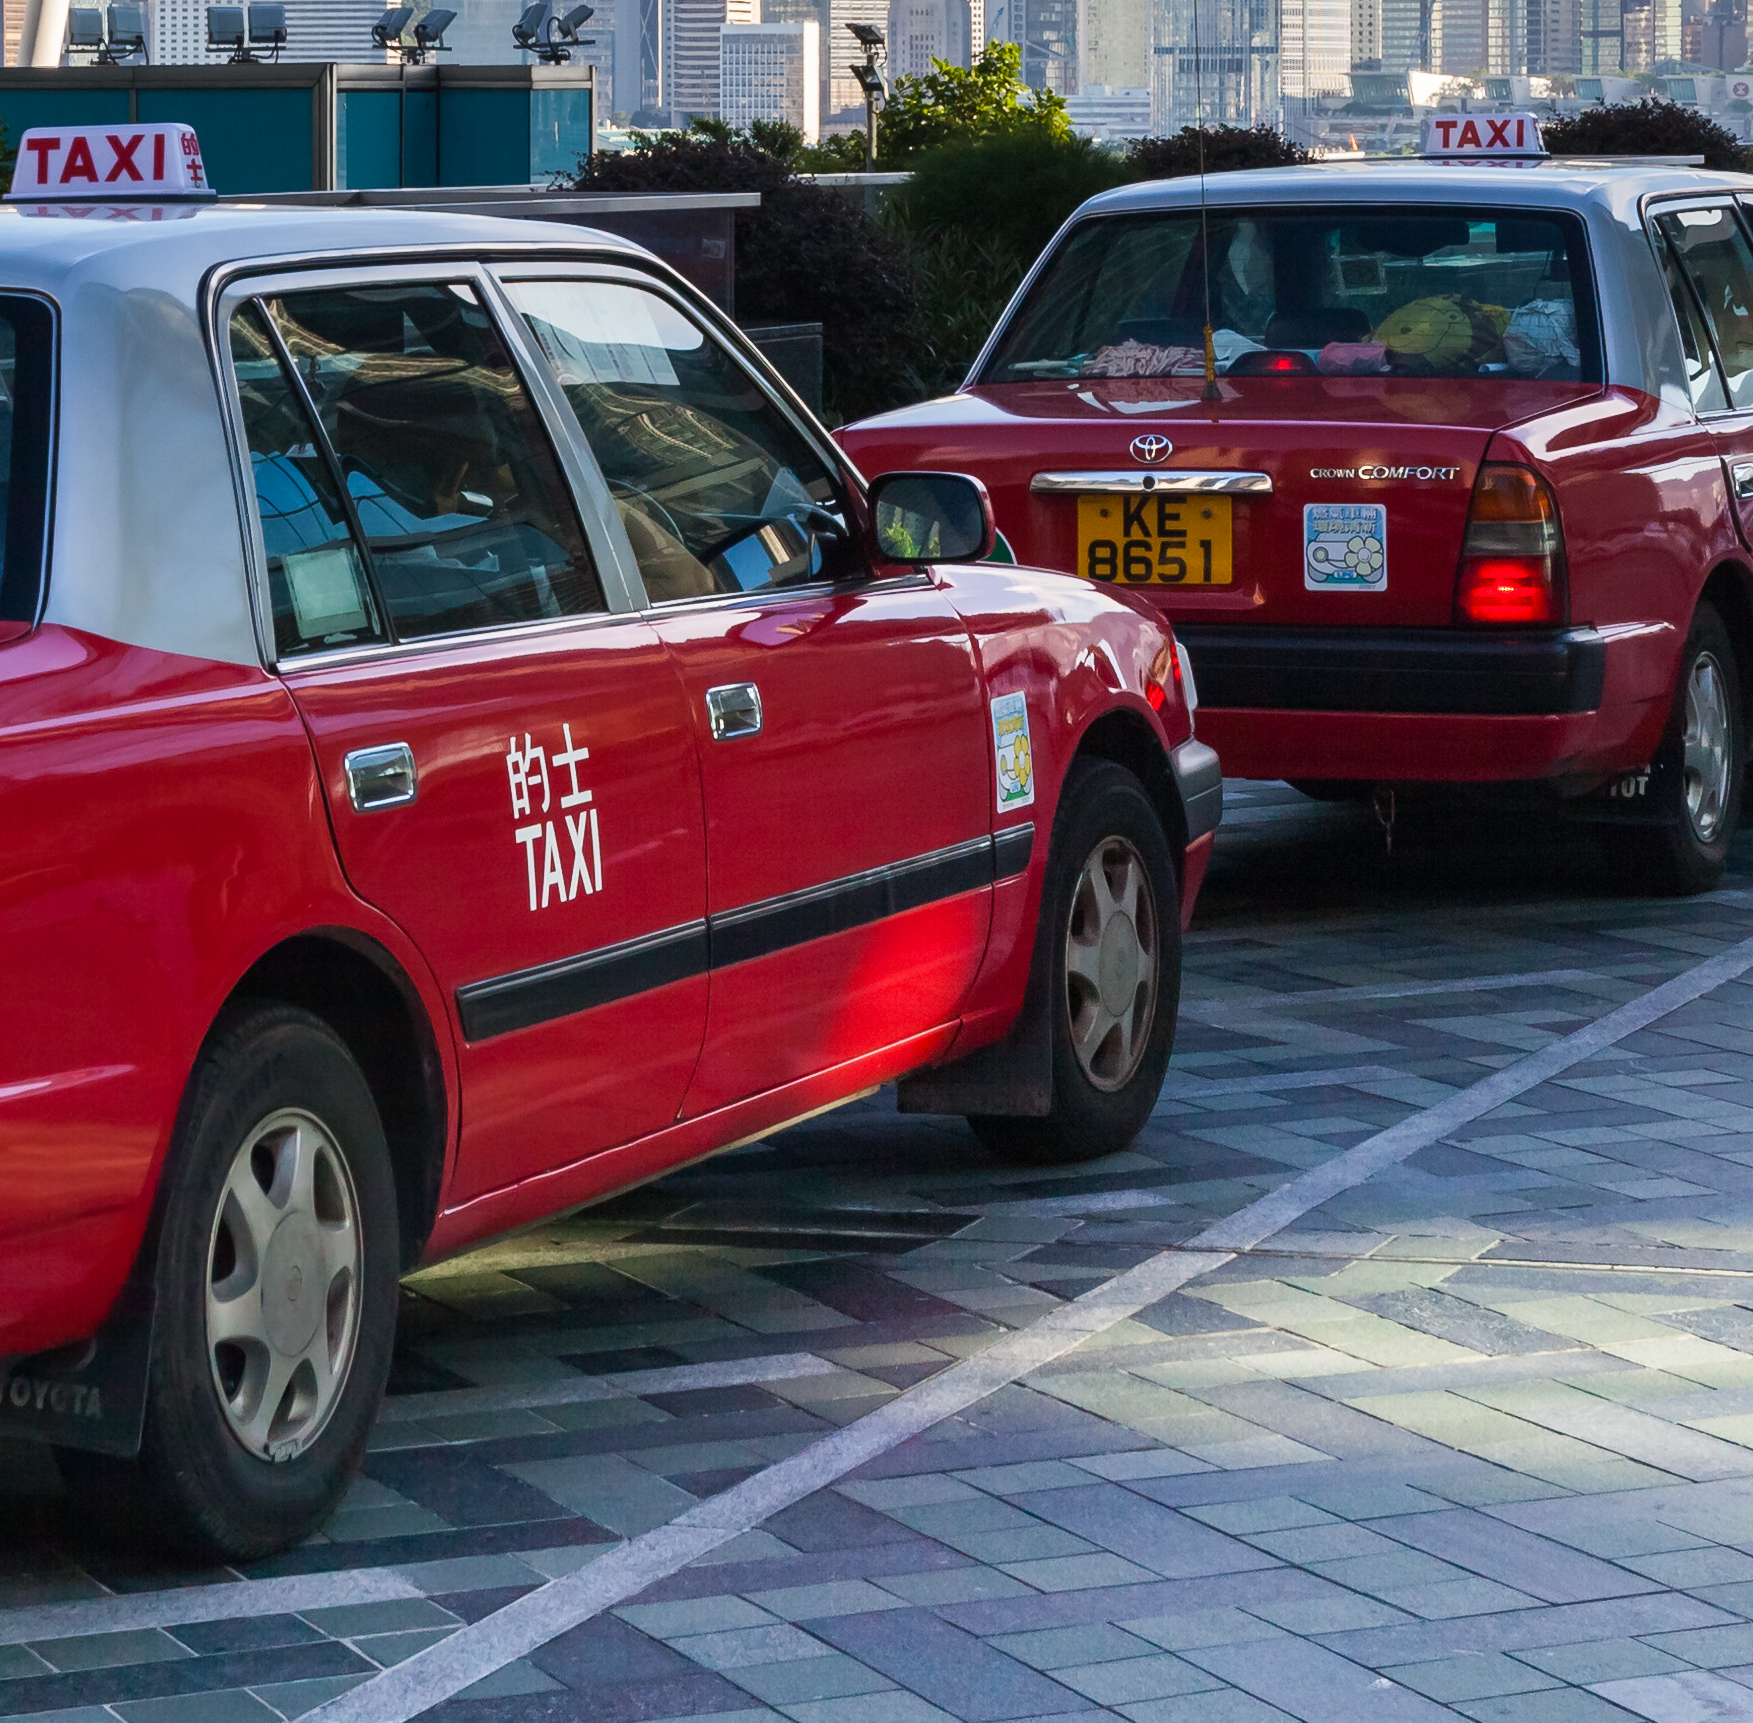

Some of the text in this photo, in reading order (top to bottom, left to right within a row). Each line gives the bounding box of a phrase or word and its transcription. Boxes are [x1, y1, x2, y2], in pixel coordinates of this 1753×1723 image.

[180, 132, 204, 182] 的士
[1435, 119, 1525, 148] TAXI
[26, 133, 165, 184] TAXI
[1310, 465, 1461, 480] CROWN COMFORT
[1123, 496, 1188, 538] KE
[1088, 539, 1213, 583] 8651
[506, 723, 593, 820] 的士
[515, 808, 603, 912] TAXI
